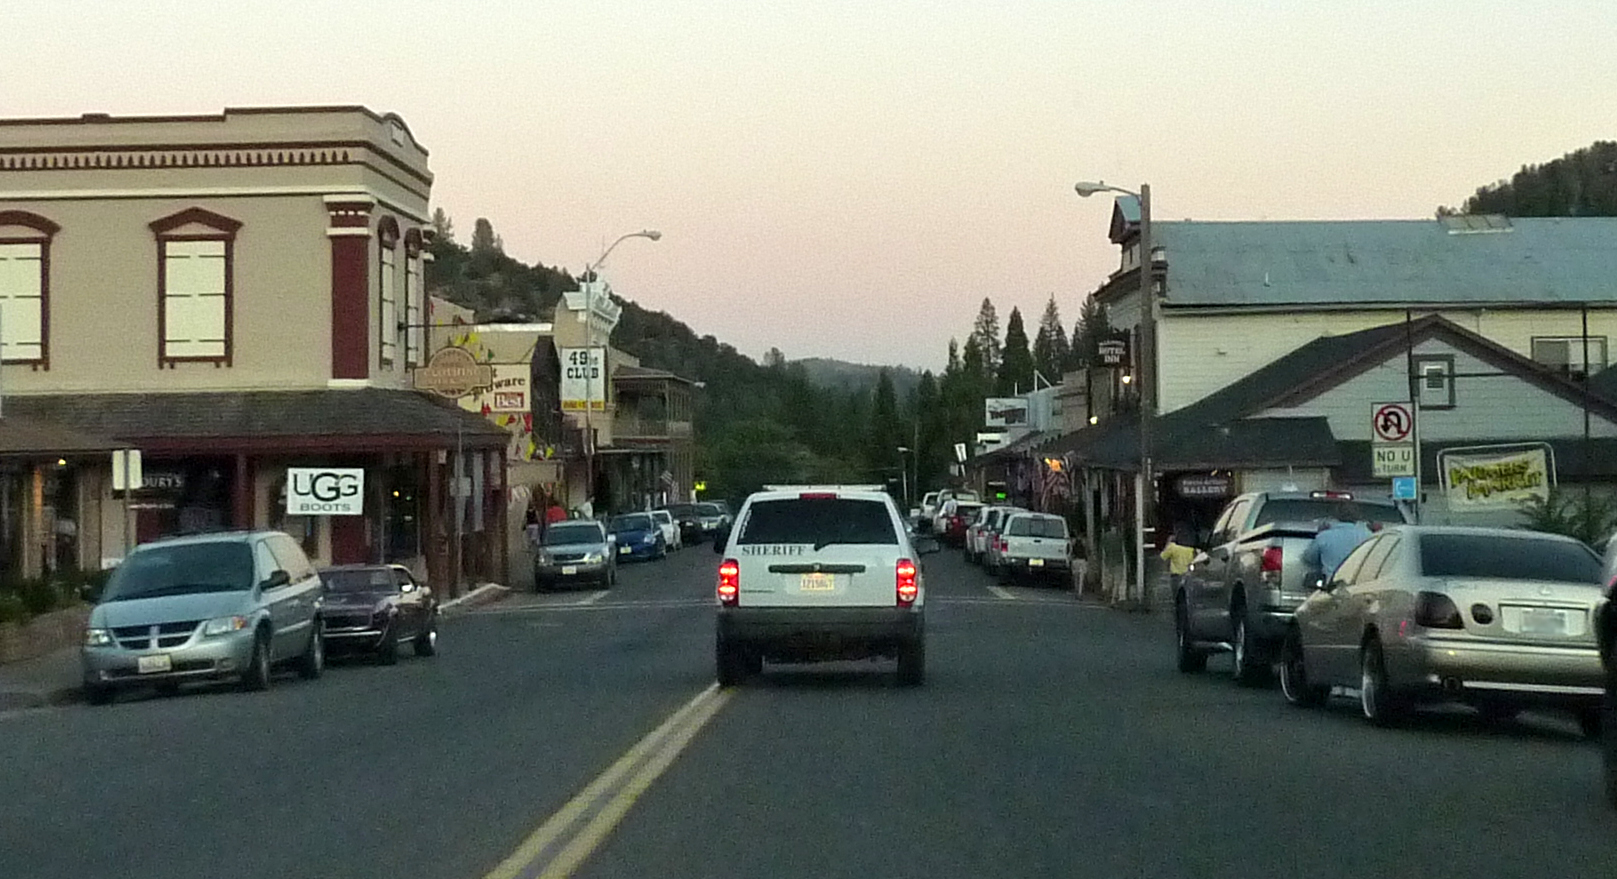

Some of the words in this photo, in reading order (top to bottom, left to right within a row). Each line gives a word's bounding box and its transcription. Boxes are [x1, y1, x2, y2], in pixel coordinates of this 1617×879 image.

[567, 367, 599, 379] CLUB
[1377, 451, 1396, 462] NO
[1401, 451, 1411, 461] U
[1383, 464, 1407, 472] TURN
[293, 472, 358, 502] UGG
[300, 503, 351, 512] BOOTS
[742, 545, 806, 556] SHERIFF
